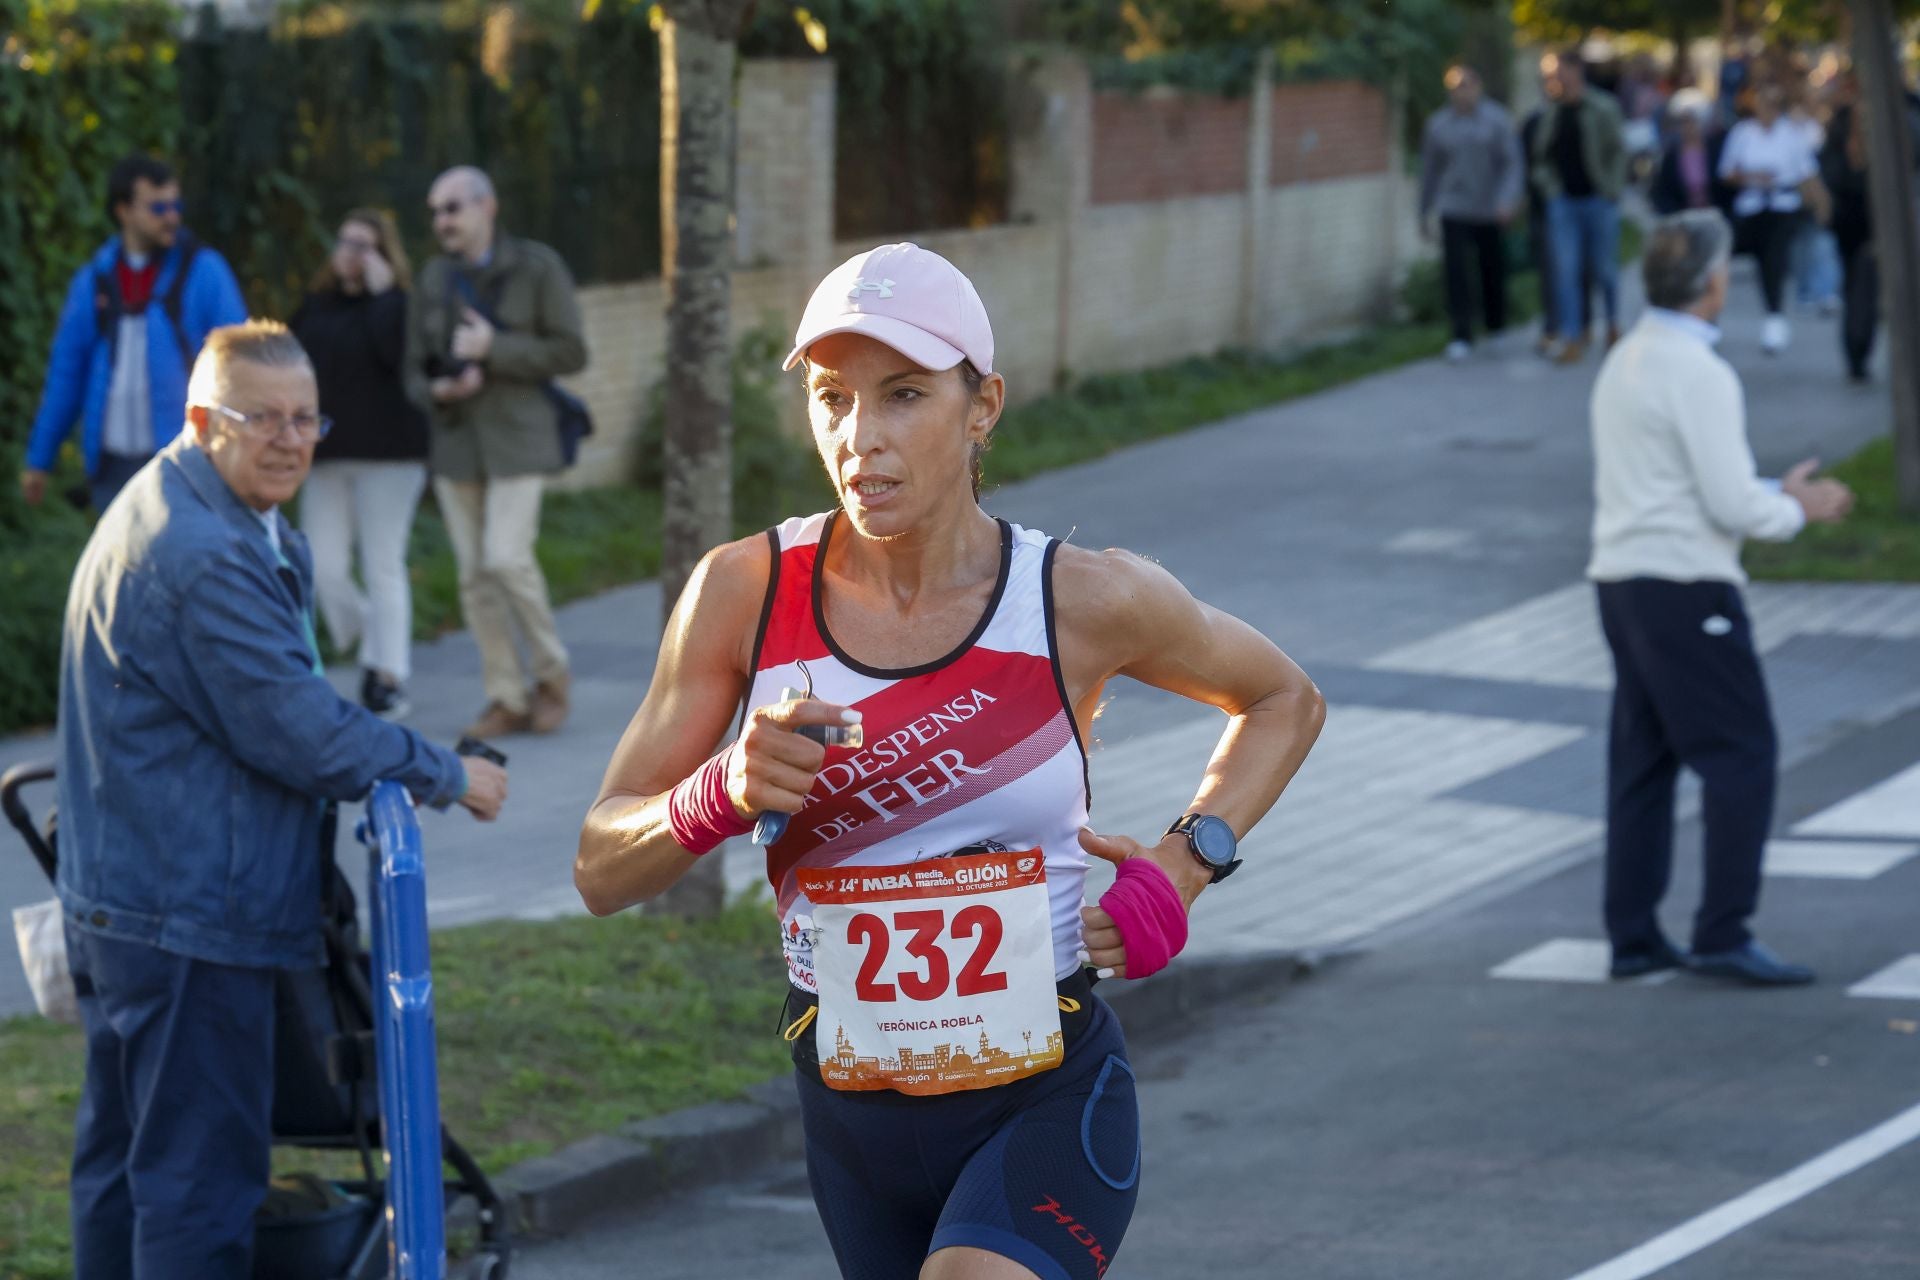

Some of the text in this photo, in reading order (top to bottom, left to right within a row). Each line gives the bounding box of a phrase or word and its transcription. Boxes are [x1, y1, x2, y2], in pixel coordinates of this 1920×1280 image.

[816, 687, 998, 796] DESPENSA
[811, 748, 992, 843] DE FER
[862, 873, 913, 892] MBA
[915, 869, 944, 880] media
[955, 863, 1008, 885] GIJÓN
[915, 877, 955, 888] maratón
[966, 881, 993, 891] OCTUBRE
[995, 879, 1008, 888] 2025
[846, 904, 1008, 1002] 232
[876, 1014, 984, 1032] VERÓNICA ROBLA
[907, 1073, 930, 1084] gijón
[985, 1065, 1017, 1075] SIROKO
